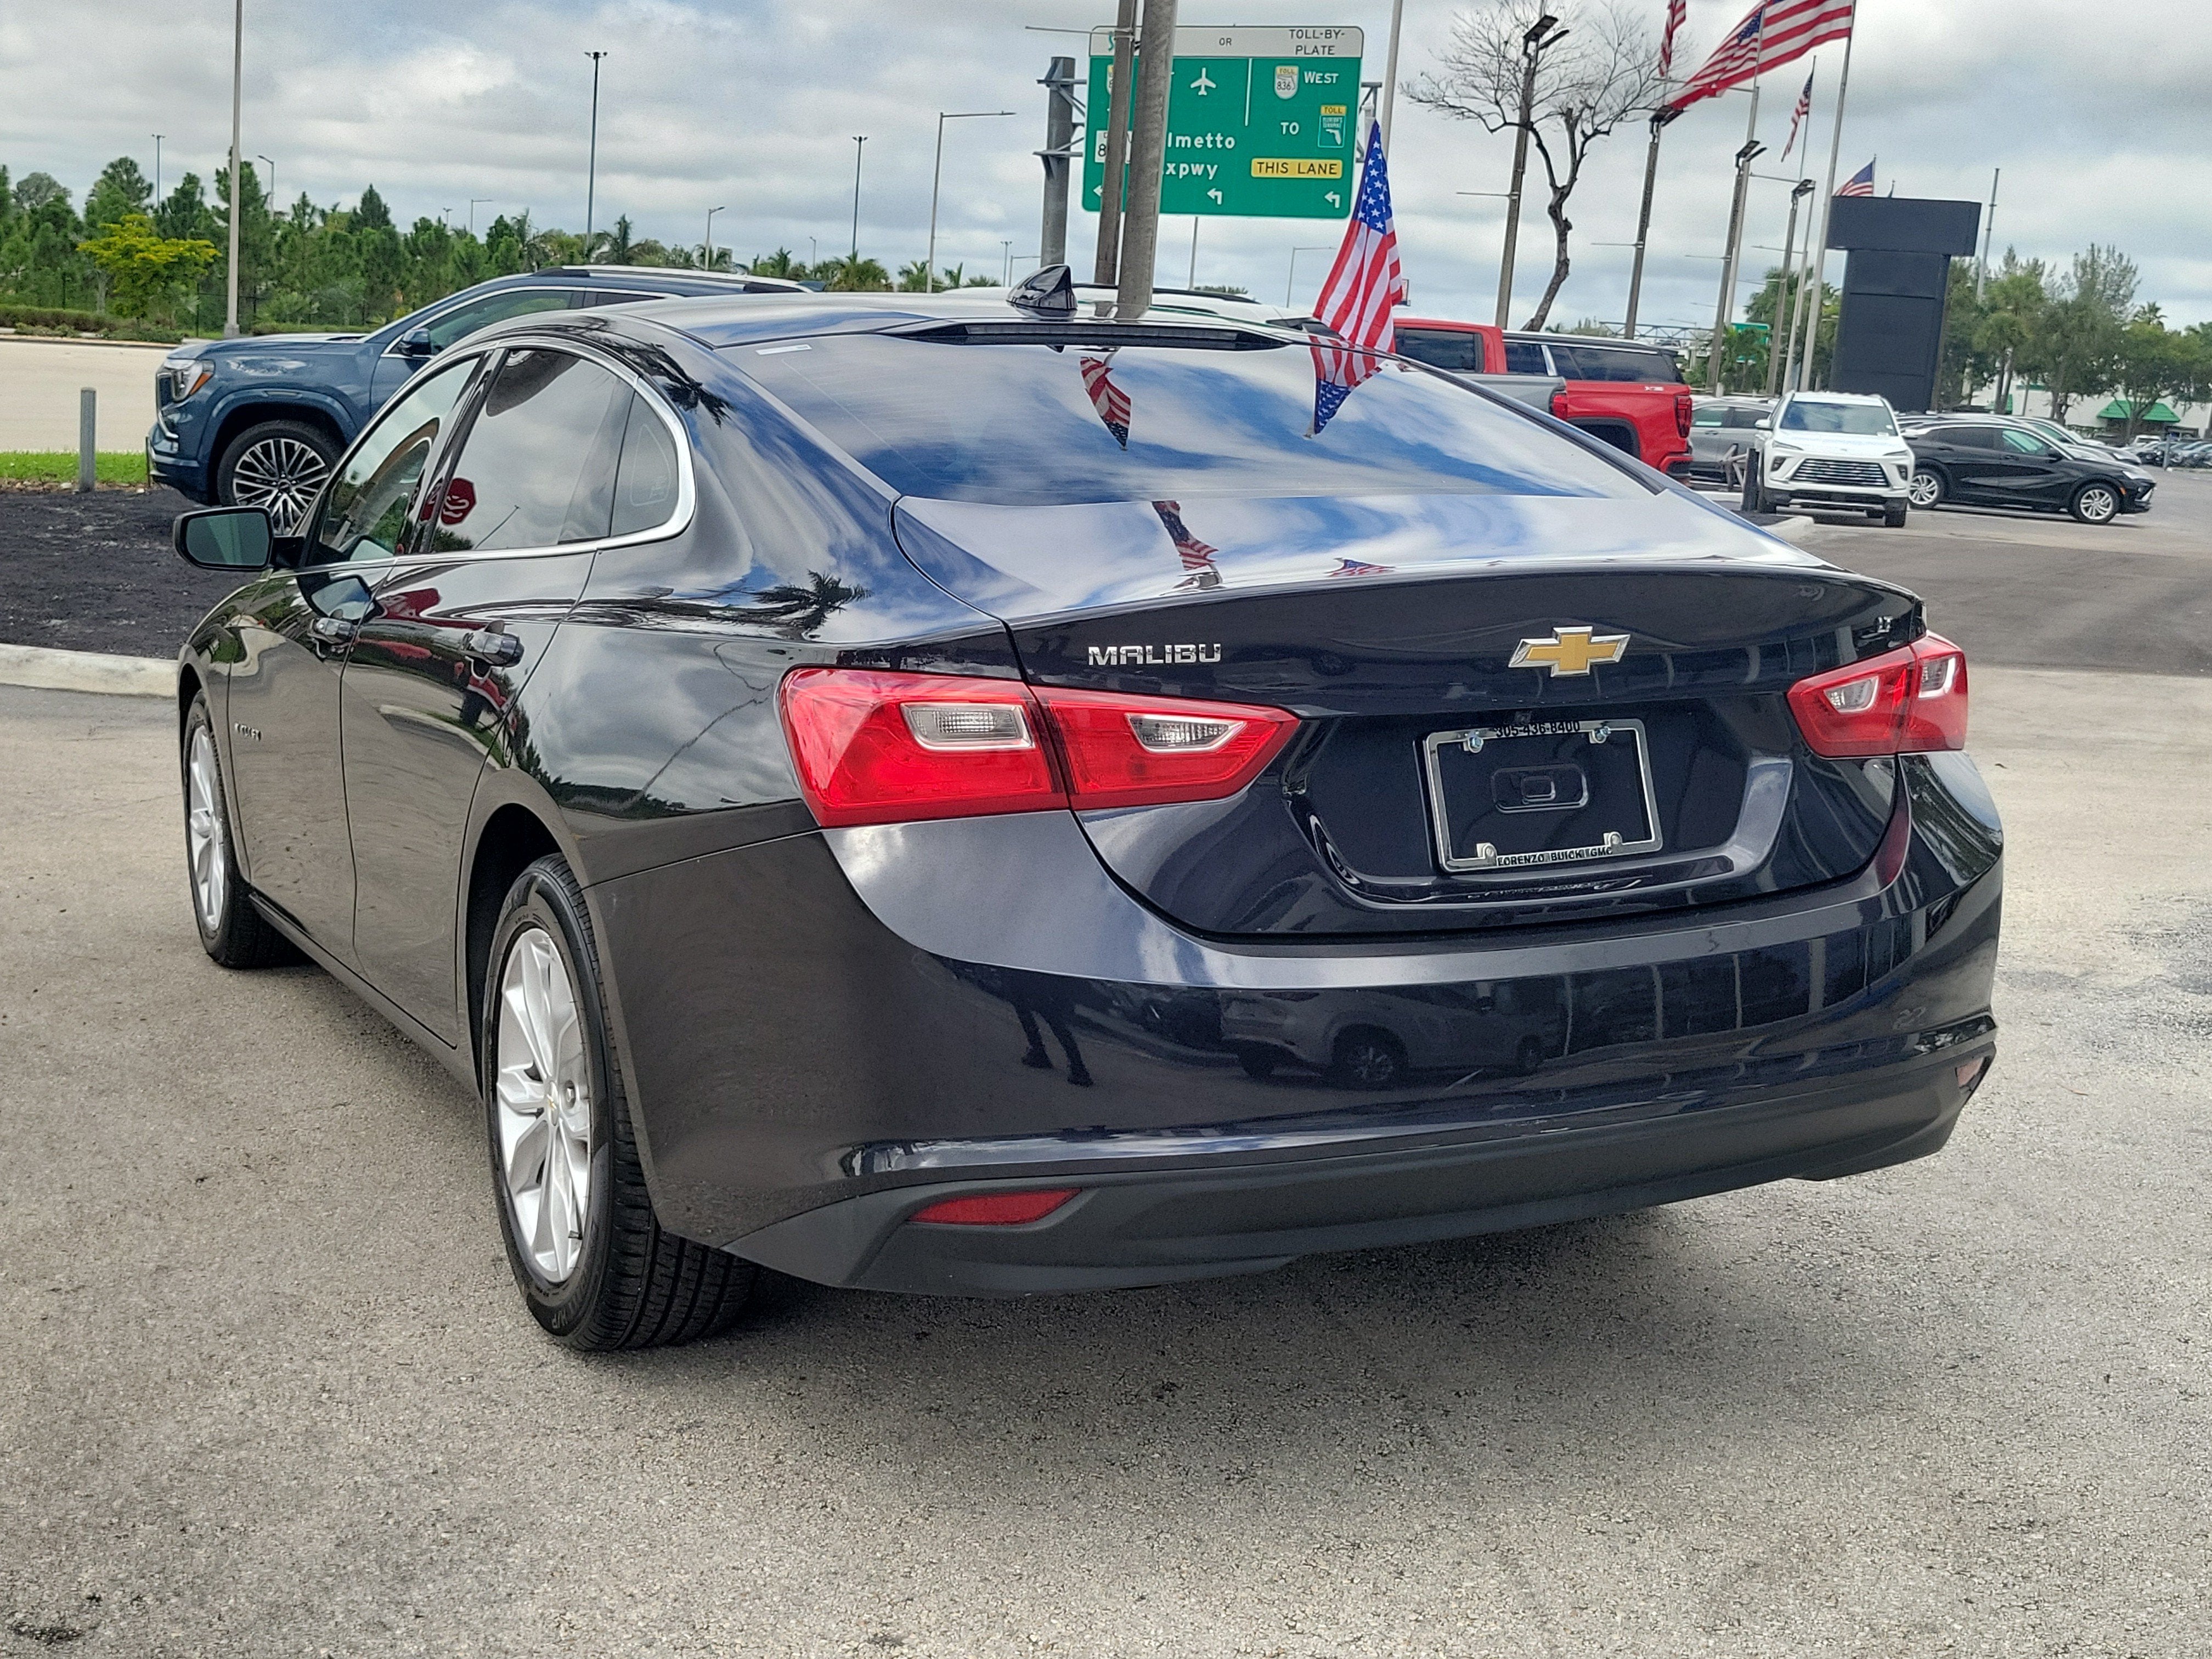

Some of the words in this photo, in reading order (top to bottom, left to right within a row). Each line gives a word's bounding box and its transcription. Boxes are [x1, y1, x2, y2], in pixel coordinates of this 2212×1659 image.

[1289, 29, 1345, 40] TOLL-BY-
[1218, 37, 1232, 46] OR
[1295, 46, 1335, 55] PLATE
[1304, 71, 1339, 84] WEST
[1276, 81, 1291, 91] 836
[1280, 122, 1300, 135] TO
[1167, 132, 1235, 149] lmetto
[1164, 162, 1218, 180] xpwy
[1257, 162, 1289, 174] THIS
[1297, 163, 1338, 175] LANE
[1877, 616, 1893, 633] LT
[1088, 644, 1221, 666] MALIBU
[1494, 720, 1581, 738] 305-436-8400
[1498, 854, 1545, 867] LORENZO
[1550, 849, 1582, 862] BUICK
[1590, 846, 1613, 857] GMC
